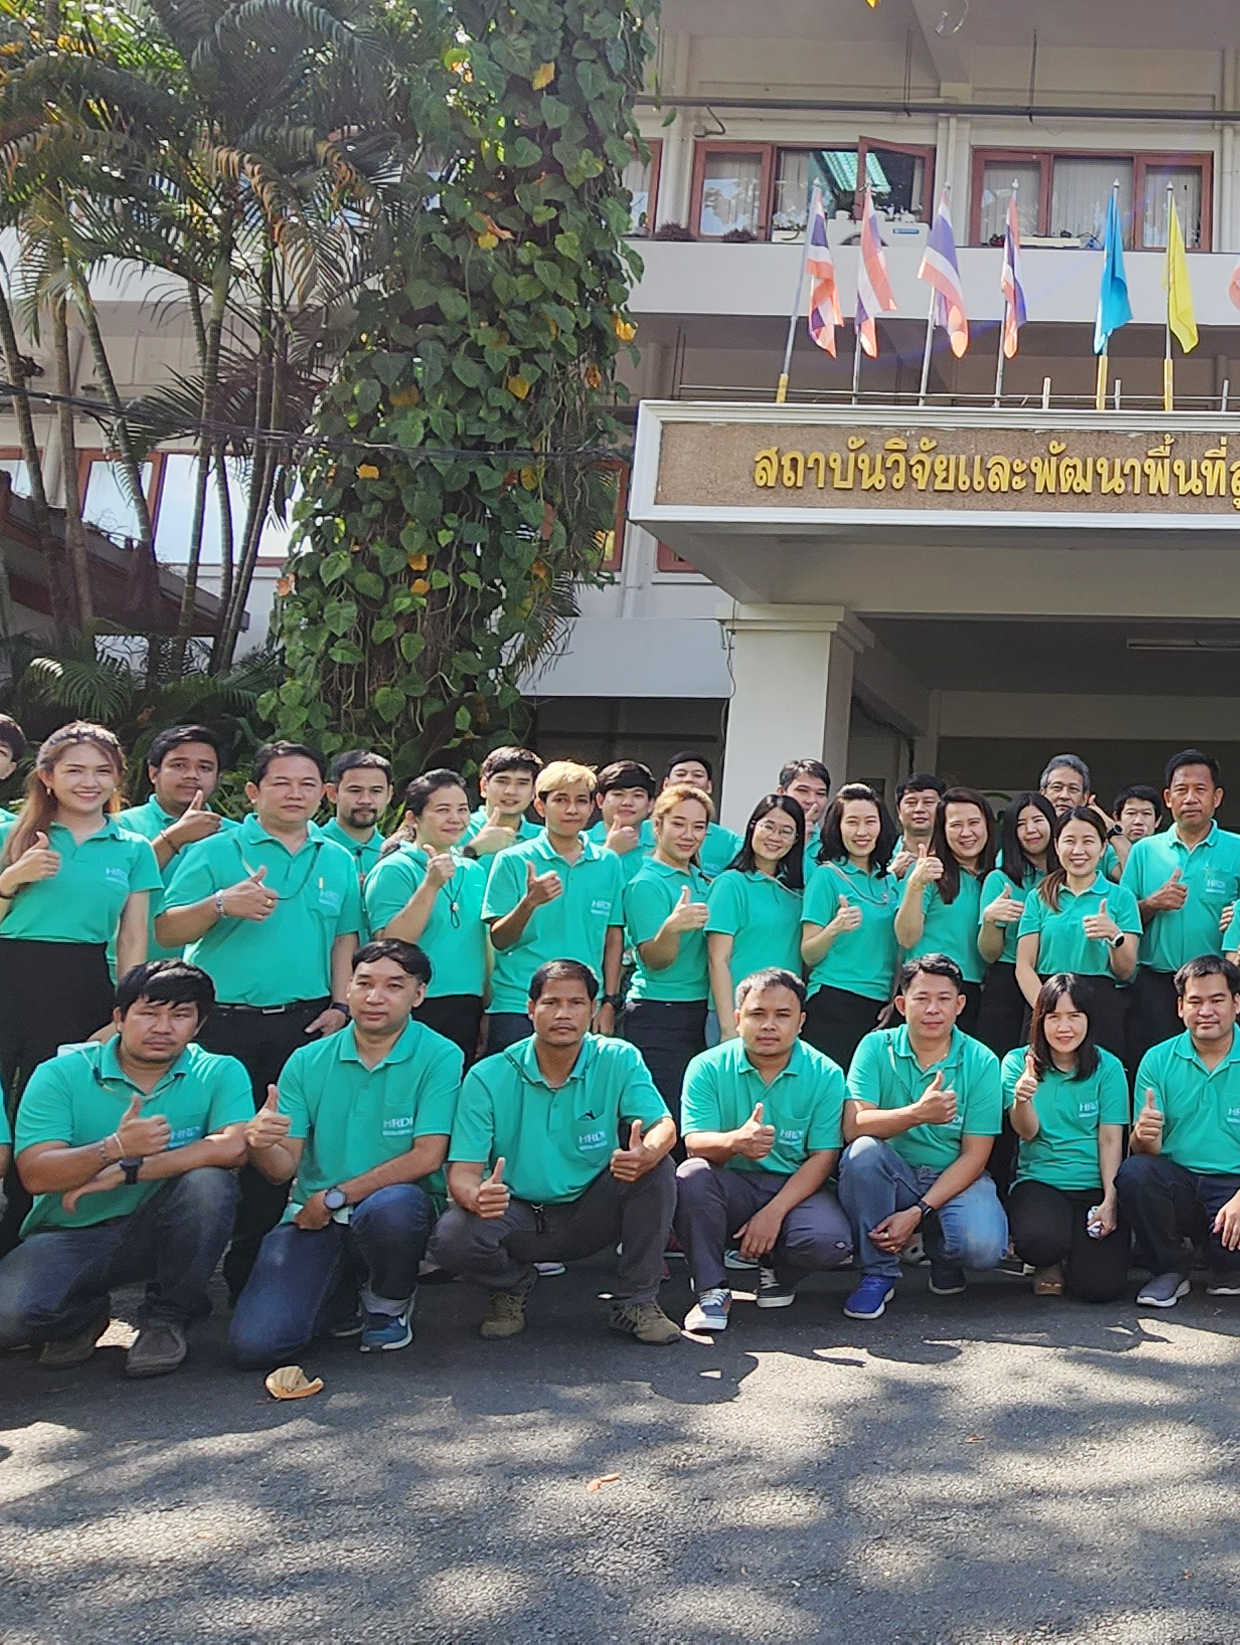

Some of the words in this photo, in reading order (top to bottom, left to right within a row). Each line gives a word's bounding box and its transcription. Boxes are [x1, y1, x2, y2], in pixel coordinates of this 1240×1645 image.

[383, 1116, 413, 1129] HRDI
[579, 1131, 606, 1143] HRDI
[781, 1129, 804, 1139] HRDI
